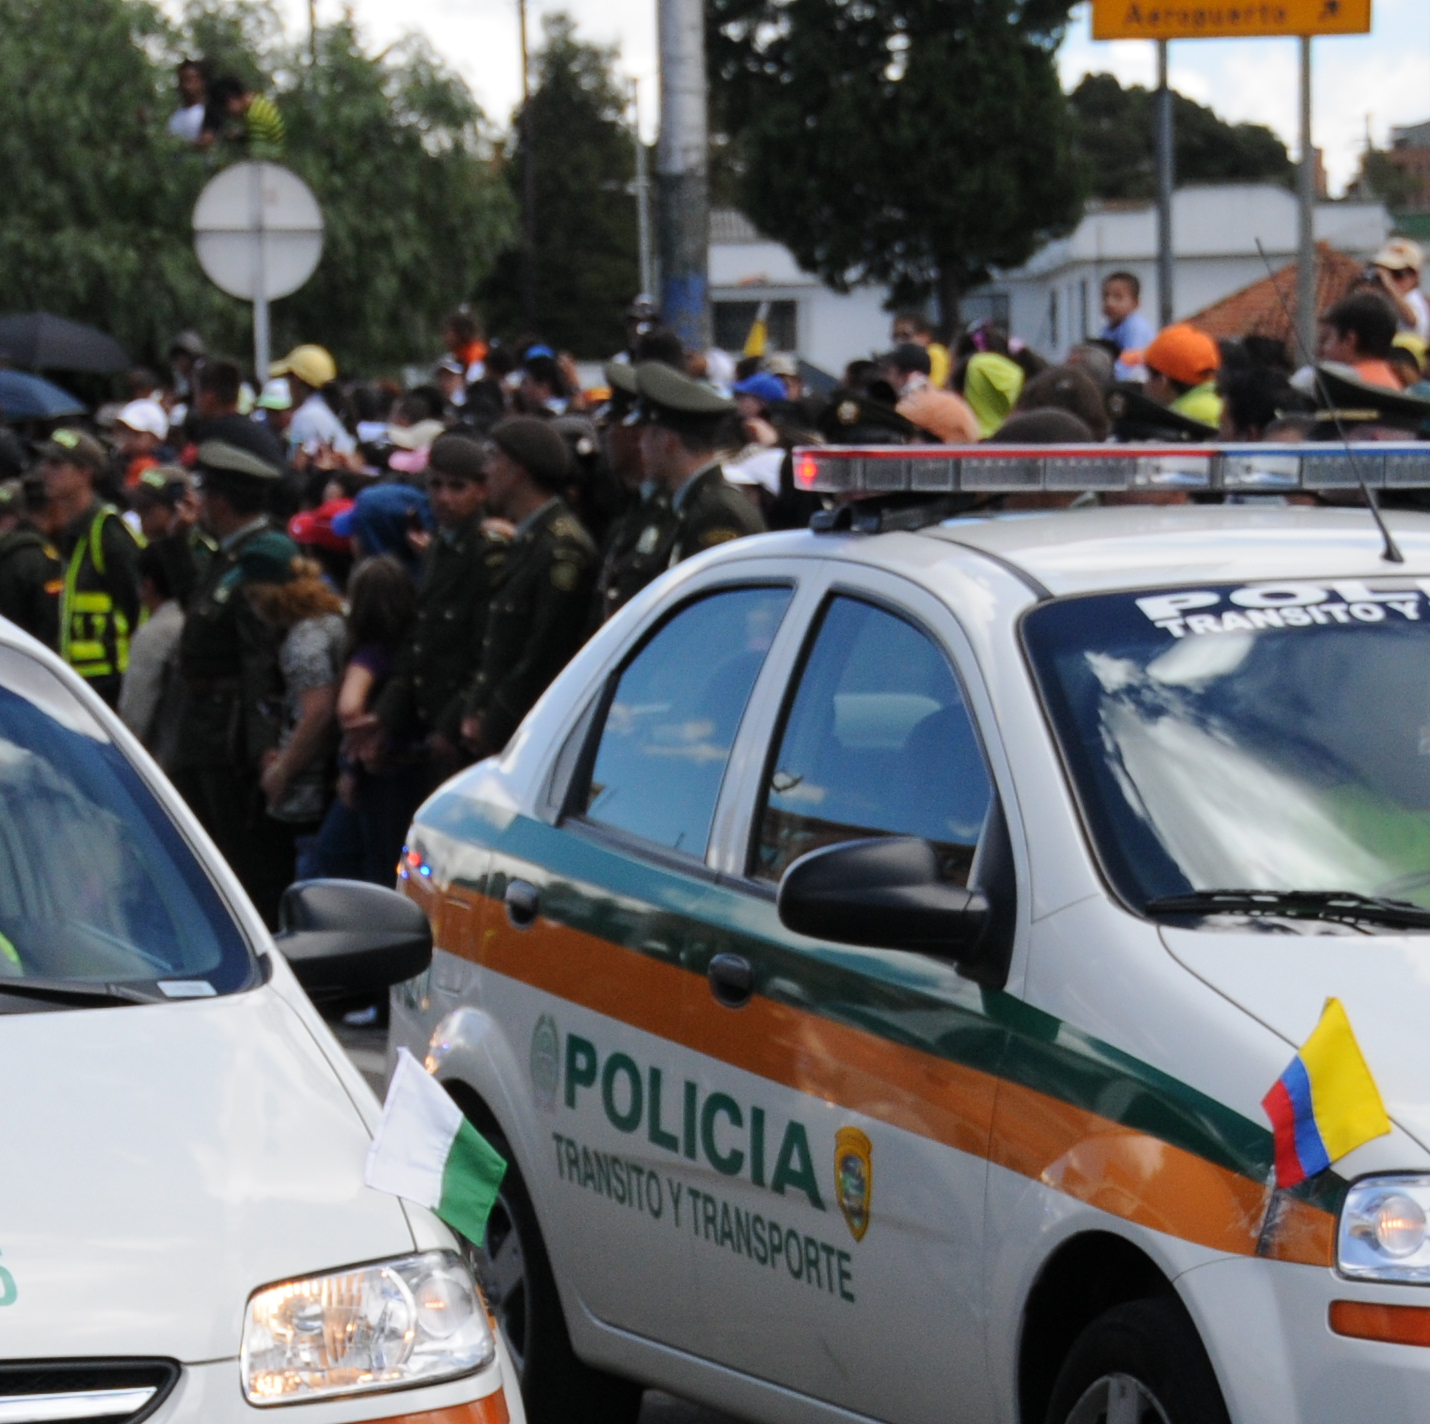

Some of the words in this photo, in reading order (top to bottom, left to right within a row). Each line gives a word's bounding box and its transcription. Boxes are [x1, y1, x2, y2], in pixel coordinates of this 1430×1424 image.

[1126, 3, 1287, 27] Aeropuerto
[1154, 601, 1386, 638] TRANSITO
[1386, 601, 1420, 621] Y
[564, 1032, 827, 1212] POLICIA
[552, 1131, 663, 1220] TRANSITO
[666, 1177, 683, 1228] Y
[687, 1187, 856, 1304] TRANSPORTE
